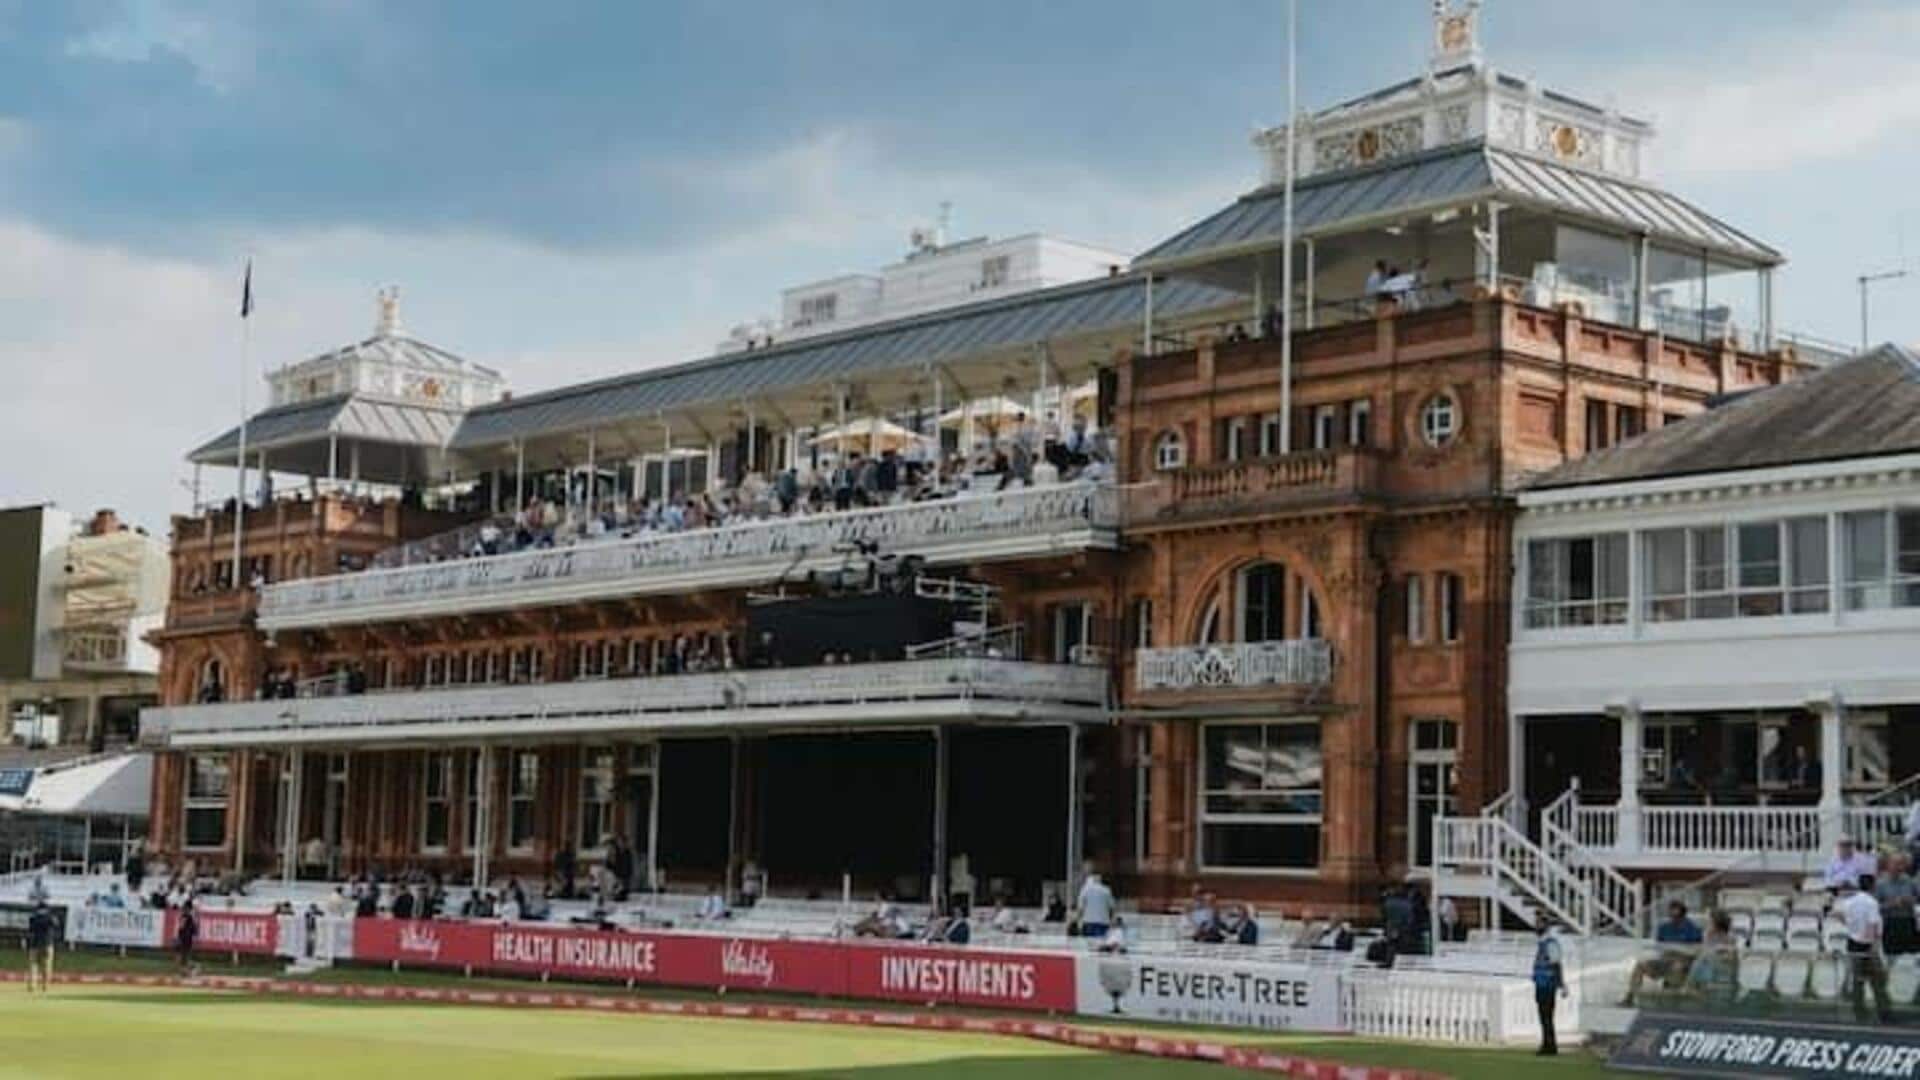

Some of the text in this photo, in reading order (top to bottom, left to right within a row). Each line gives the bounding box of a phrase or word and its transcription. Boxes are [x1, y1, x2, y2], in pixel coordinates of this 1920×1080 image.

[493, 933, 656, 972] HEALTH INSURANCE
[721, 938, 775, 986] Vitality
[881, 956, 1036, 999] INVESTMENTS
[1139, 966, 1309, 1007] FEVER-TREE
[1661, 1029, 1920, 1077] STOWFORD PRESS CIDER
